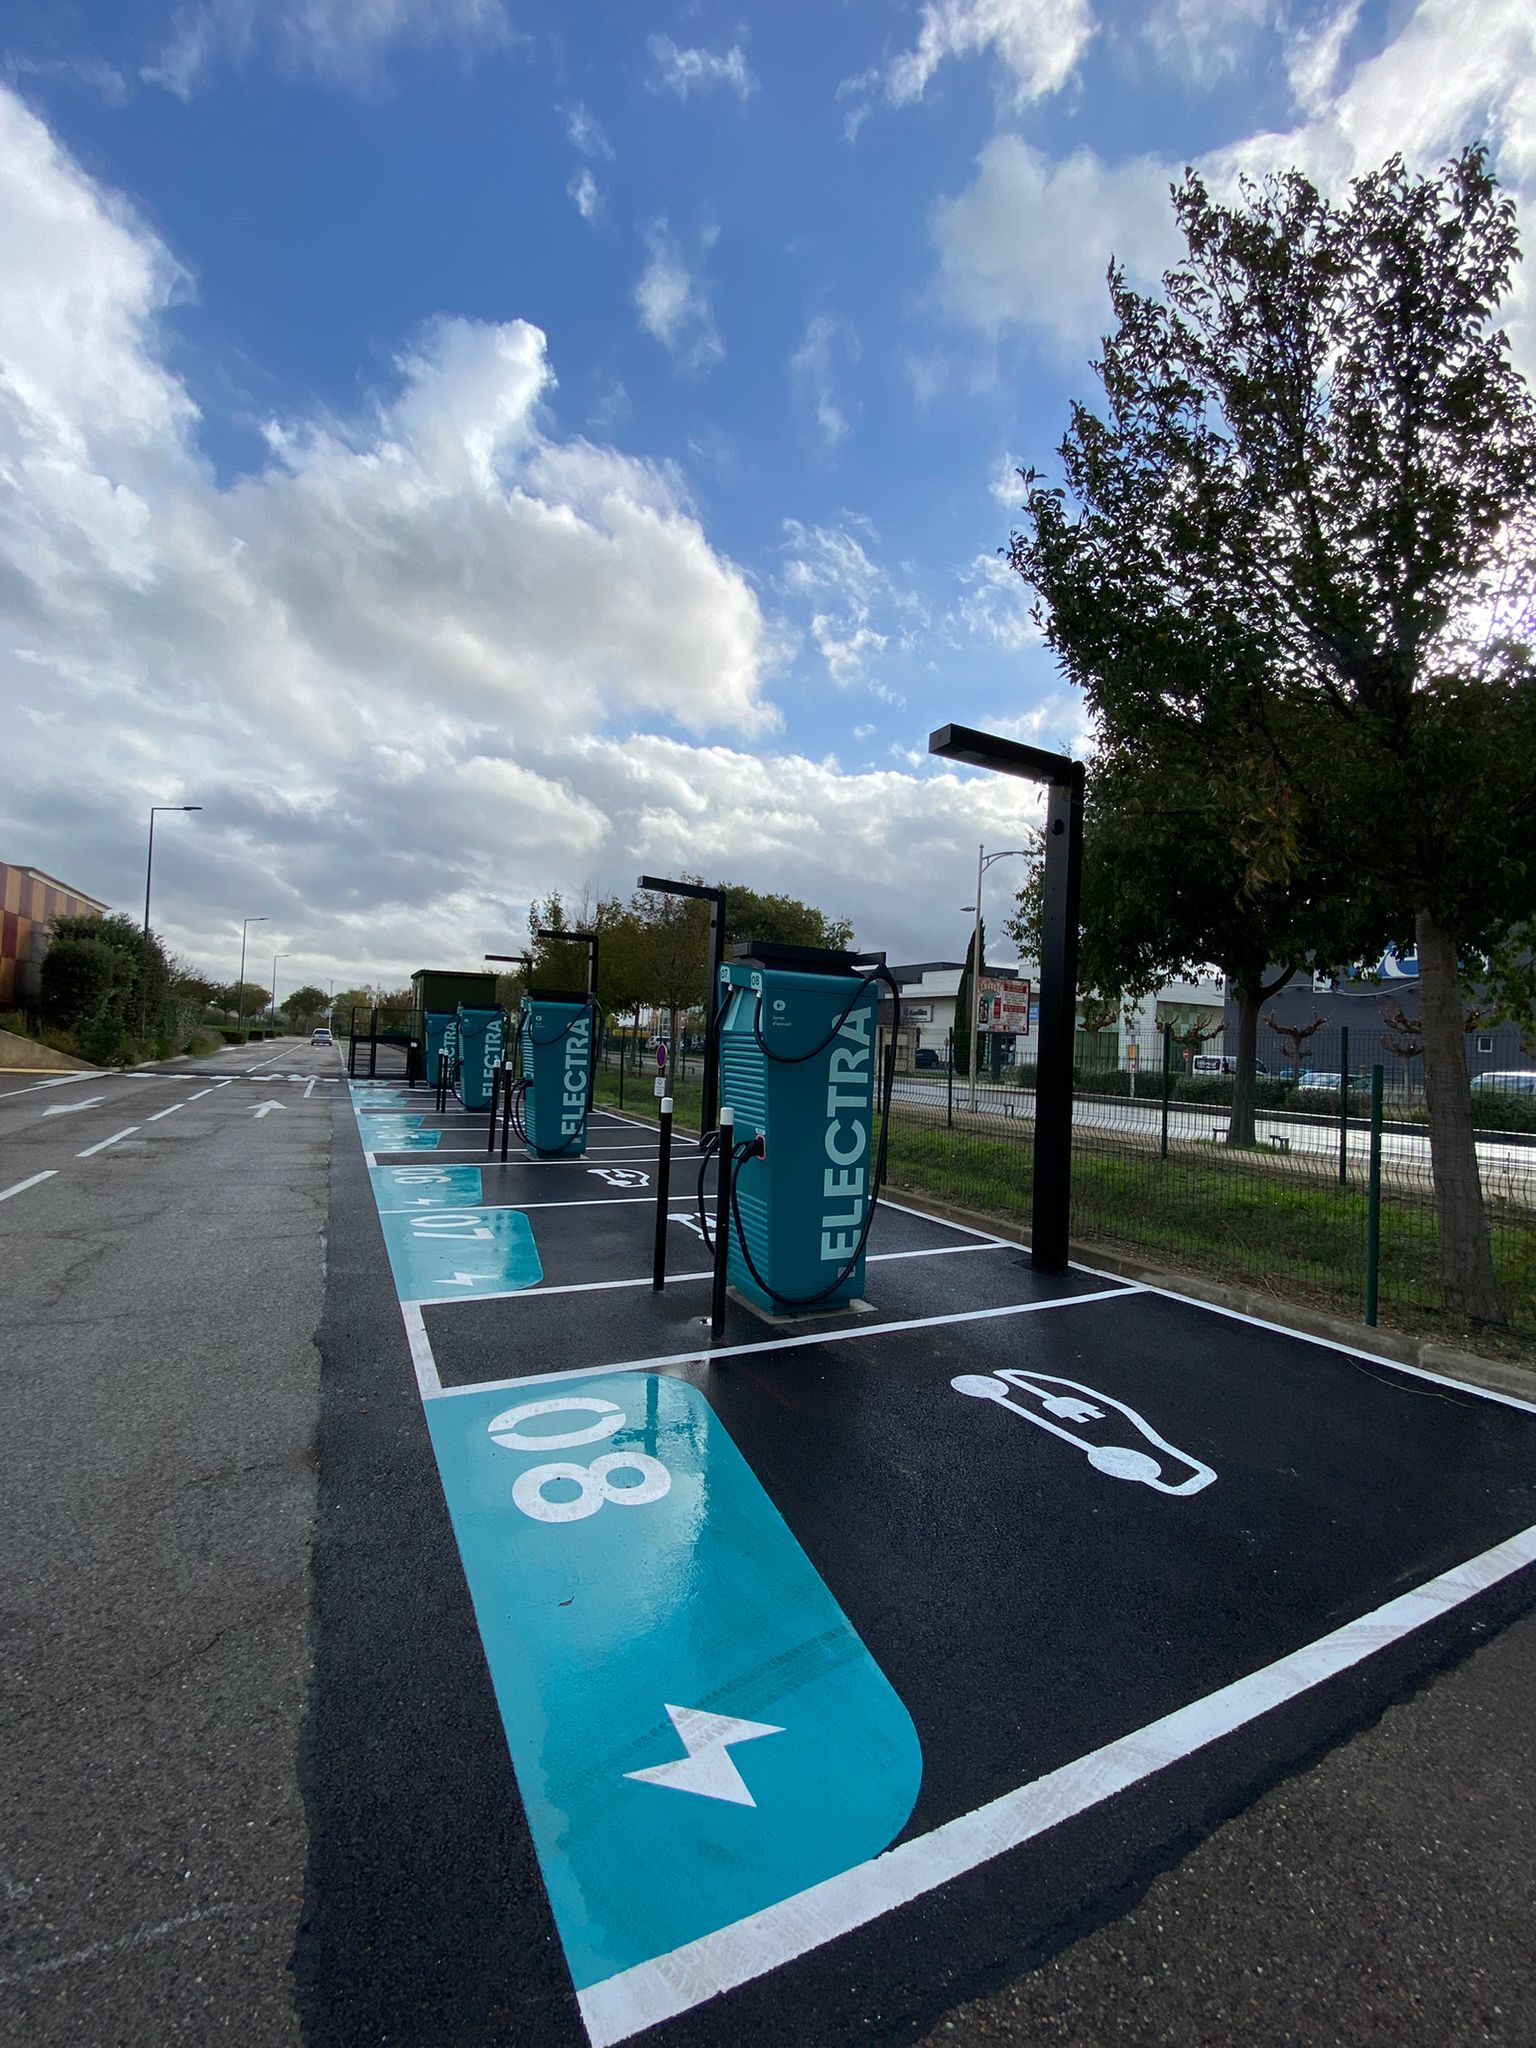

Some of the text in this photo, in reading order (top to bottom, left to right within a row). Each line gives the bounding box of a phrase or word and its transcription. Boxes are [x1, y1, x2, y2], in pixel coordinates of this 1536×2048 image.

[561, 1018, 590, 1135] ELECTRA
[820, 1006, 872, 1261] ELECTRA
[391, 1168, 451, 1184] 06
[410, 1214, 496, 1240] 07
[488, 1397, 672, 1523] 08
